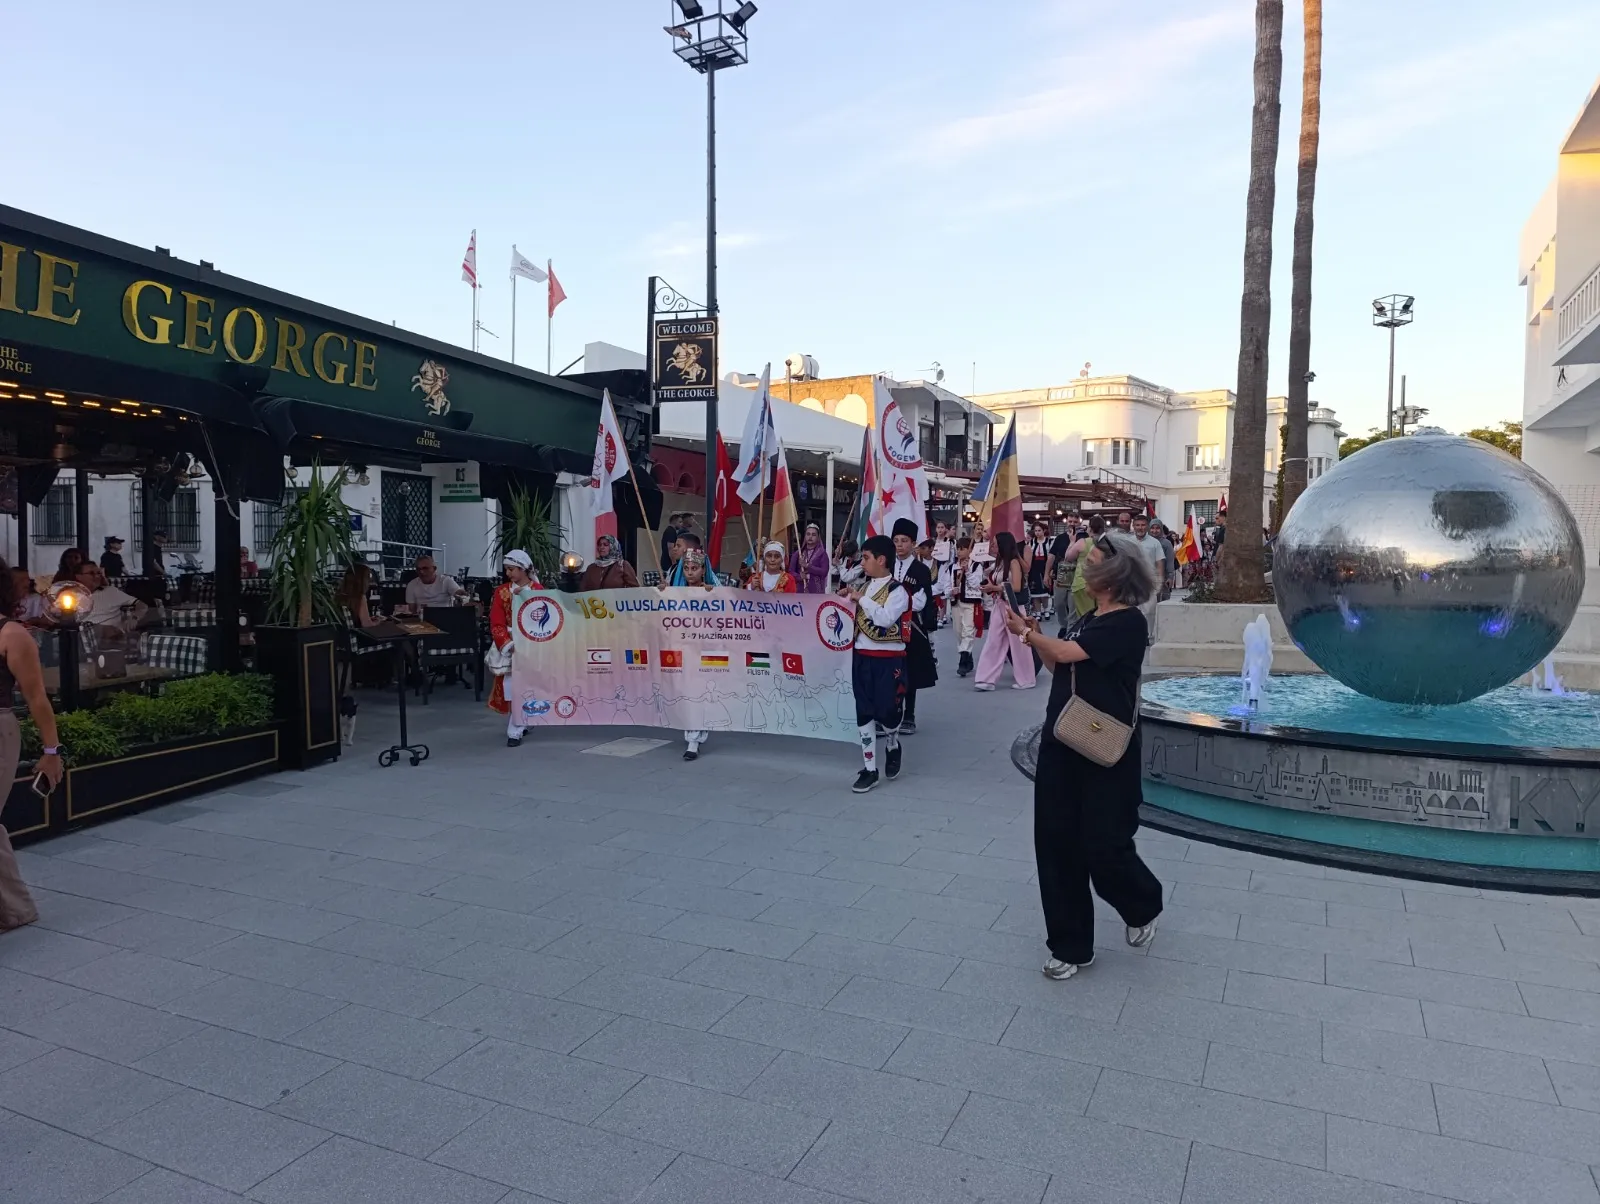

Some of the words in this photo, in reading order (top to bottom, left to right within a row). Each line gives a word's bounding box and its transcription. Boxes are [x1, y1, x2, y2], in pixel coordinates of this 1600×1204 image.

[662, 323, 712, 335] WELCOME
[122, 280, 378, 391] GEORGE
[657, 390, 676, 399] THE
[677, 388, 715, 398] GEORGE
[423, 430, 436, 439] THE
[416, 436, 441, 448] GEORGE
[887, 445, 916, 462] FOGEM
[575, 596, 615, 619] 18.
[615, 599, 725, 612] ULUSLARARASI
[729, 599, 756, 612] YAZ
[757, 600, 804, 617] SEVİNCİ
[662, 616, 713, 632] ÇOCUK
[716, 615, 765, 632] ŞENLİĞİ
[529, 630, 552, 638] FOGEM
[681, 632, 686, 640] 3
[691, 632, 697, 640] 7
[698, 632, 733, 640] HAZİRAN
[734, 633, 752, 641] 2026
[827, 637, 851, 647] FOGEM
